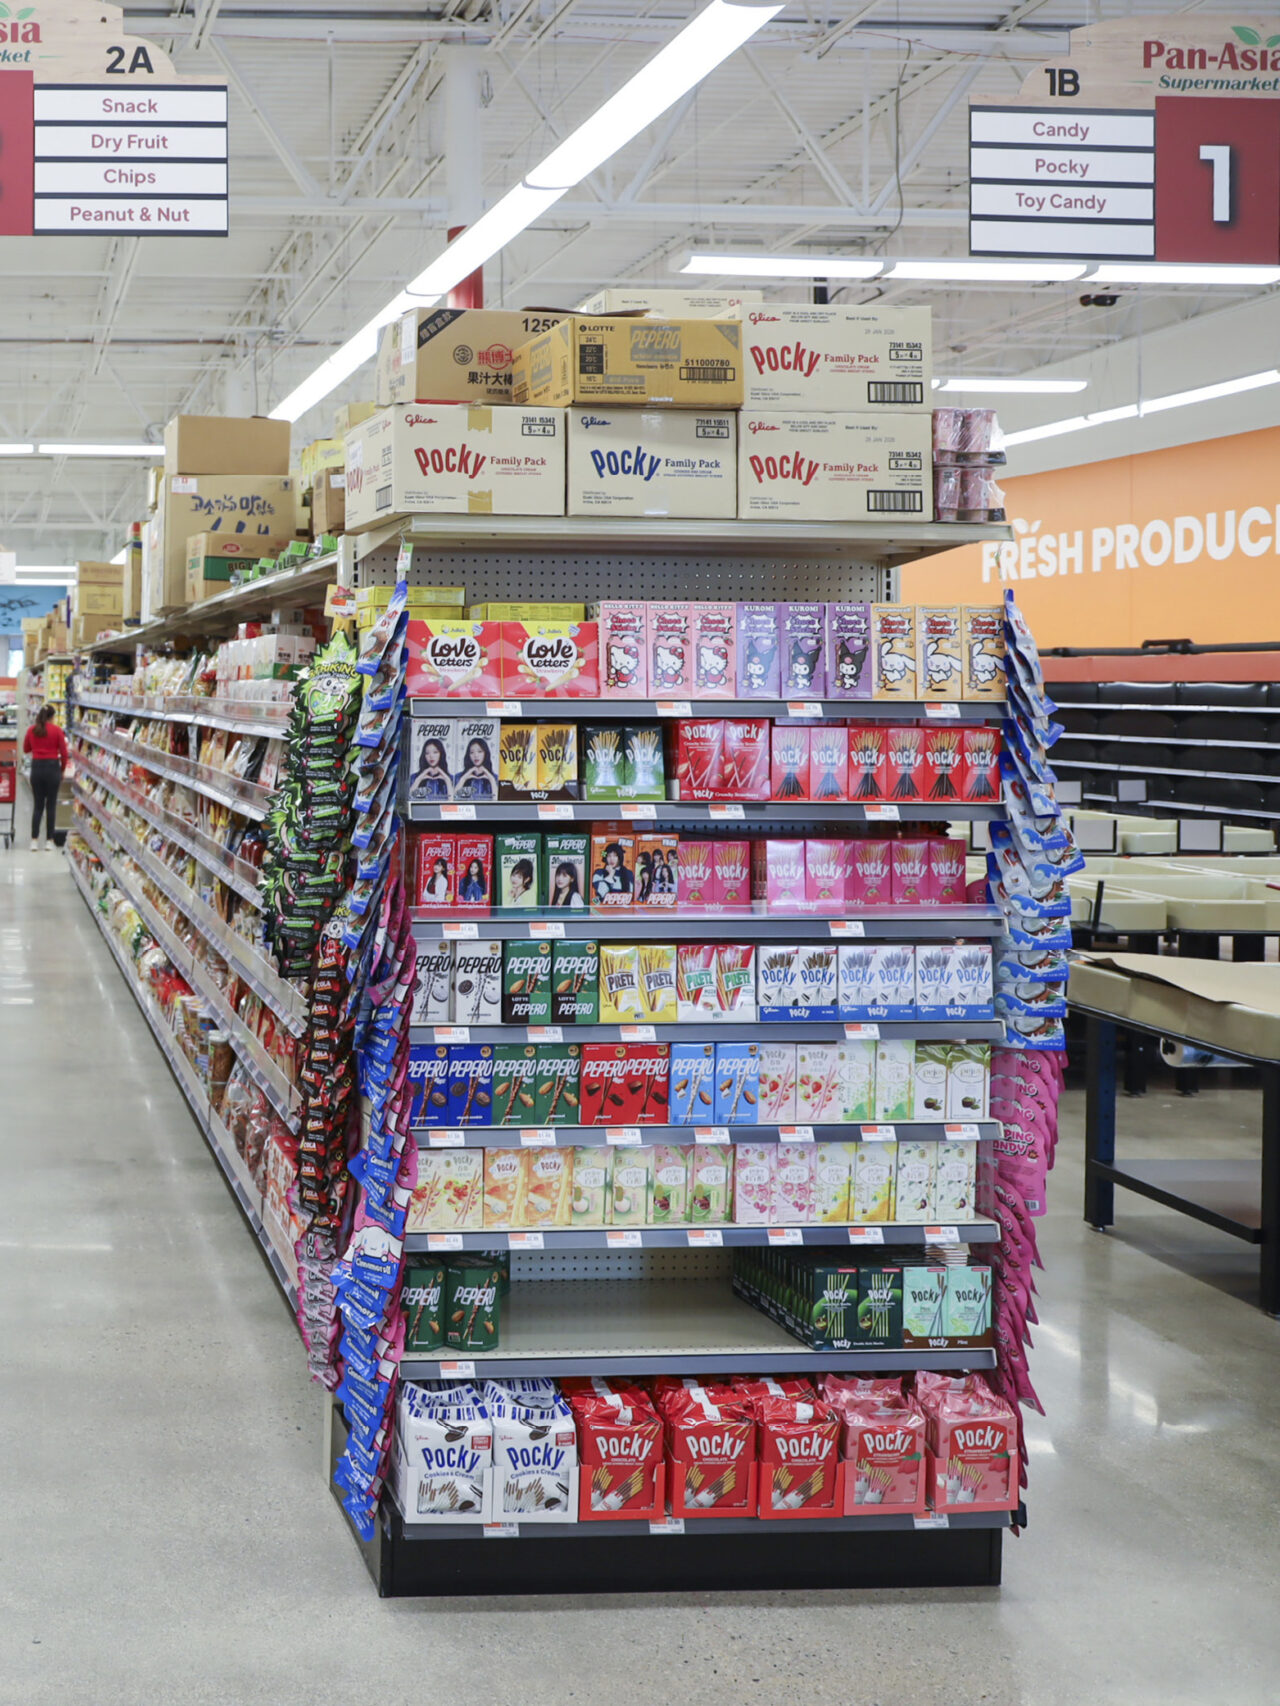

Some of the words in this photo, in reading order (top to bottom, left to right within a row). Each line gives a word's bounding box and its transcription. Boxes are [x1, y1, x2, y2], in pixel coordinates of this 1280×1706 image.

[105, 45, 154, 73] 2A
[1045, 68, 1080, 96] 1B
[1159, 75, 1278, 91] Supermarket
[102, 98, 158, 114] Snack
[1033, 122, 1089, 141] Candy
[91, 133, 122, 152] Dry
[127, 133, 168, 150] Fruit
[1035, 159, 1089, 177] Pocky
[103, 168, 156, 187] Chips
[1200, 146, 1230, 221] 1
[1016, 193, 1045, 211] Toy
[1050, 194, 1106, 213] Candy
[70, 206, 134, 222] Peanut
[140, 206, 152, 222] &
[157, 206, 190, 222] Nut
[749, 313, 781, 323] Glico
[631, 328, 681, 351] PEPERO
[405, 414, 437, 427] Glico
[581, 417, 611, 428] Glico
[749, 422, 780, 433] Glico
[490, 456, 522, 468] Family
[524, 456, 546, 466] Pack
[665, 459, 697, 470] Family
[699, 459, 720, 469] Pack
[982, 531, 1083, 583] FRESH
[1092, 505, 1280, 572] PRODUC
[431, 638, 476, 658] Love
[528, 637, 573, 659] Love
[434, 658, 473, 668] Letters
[531, 658, 569, 668] Letters
[417, 724, 450, 737] PEPERO
[424, 1471, 453, 1479] Cookies
